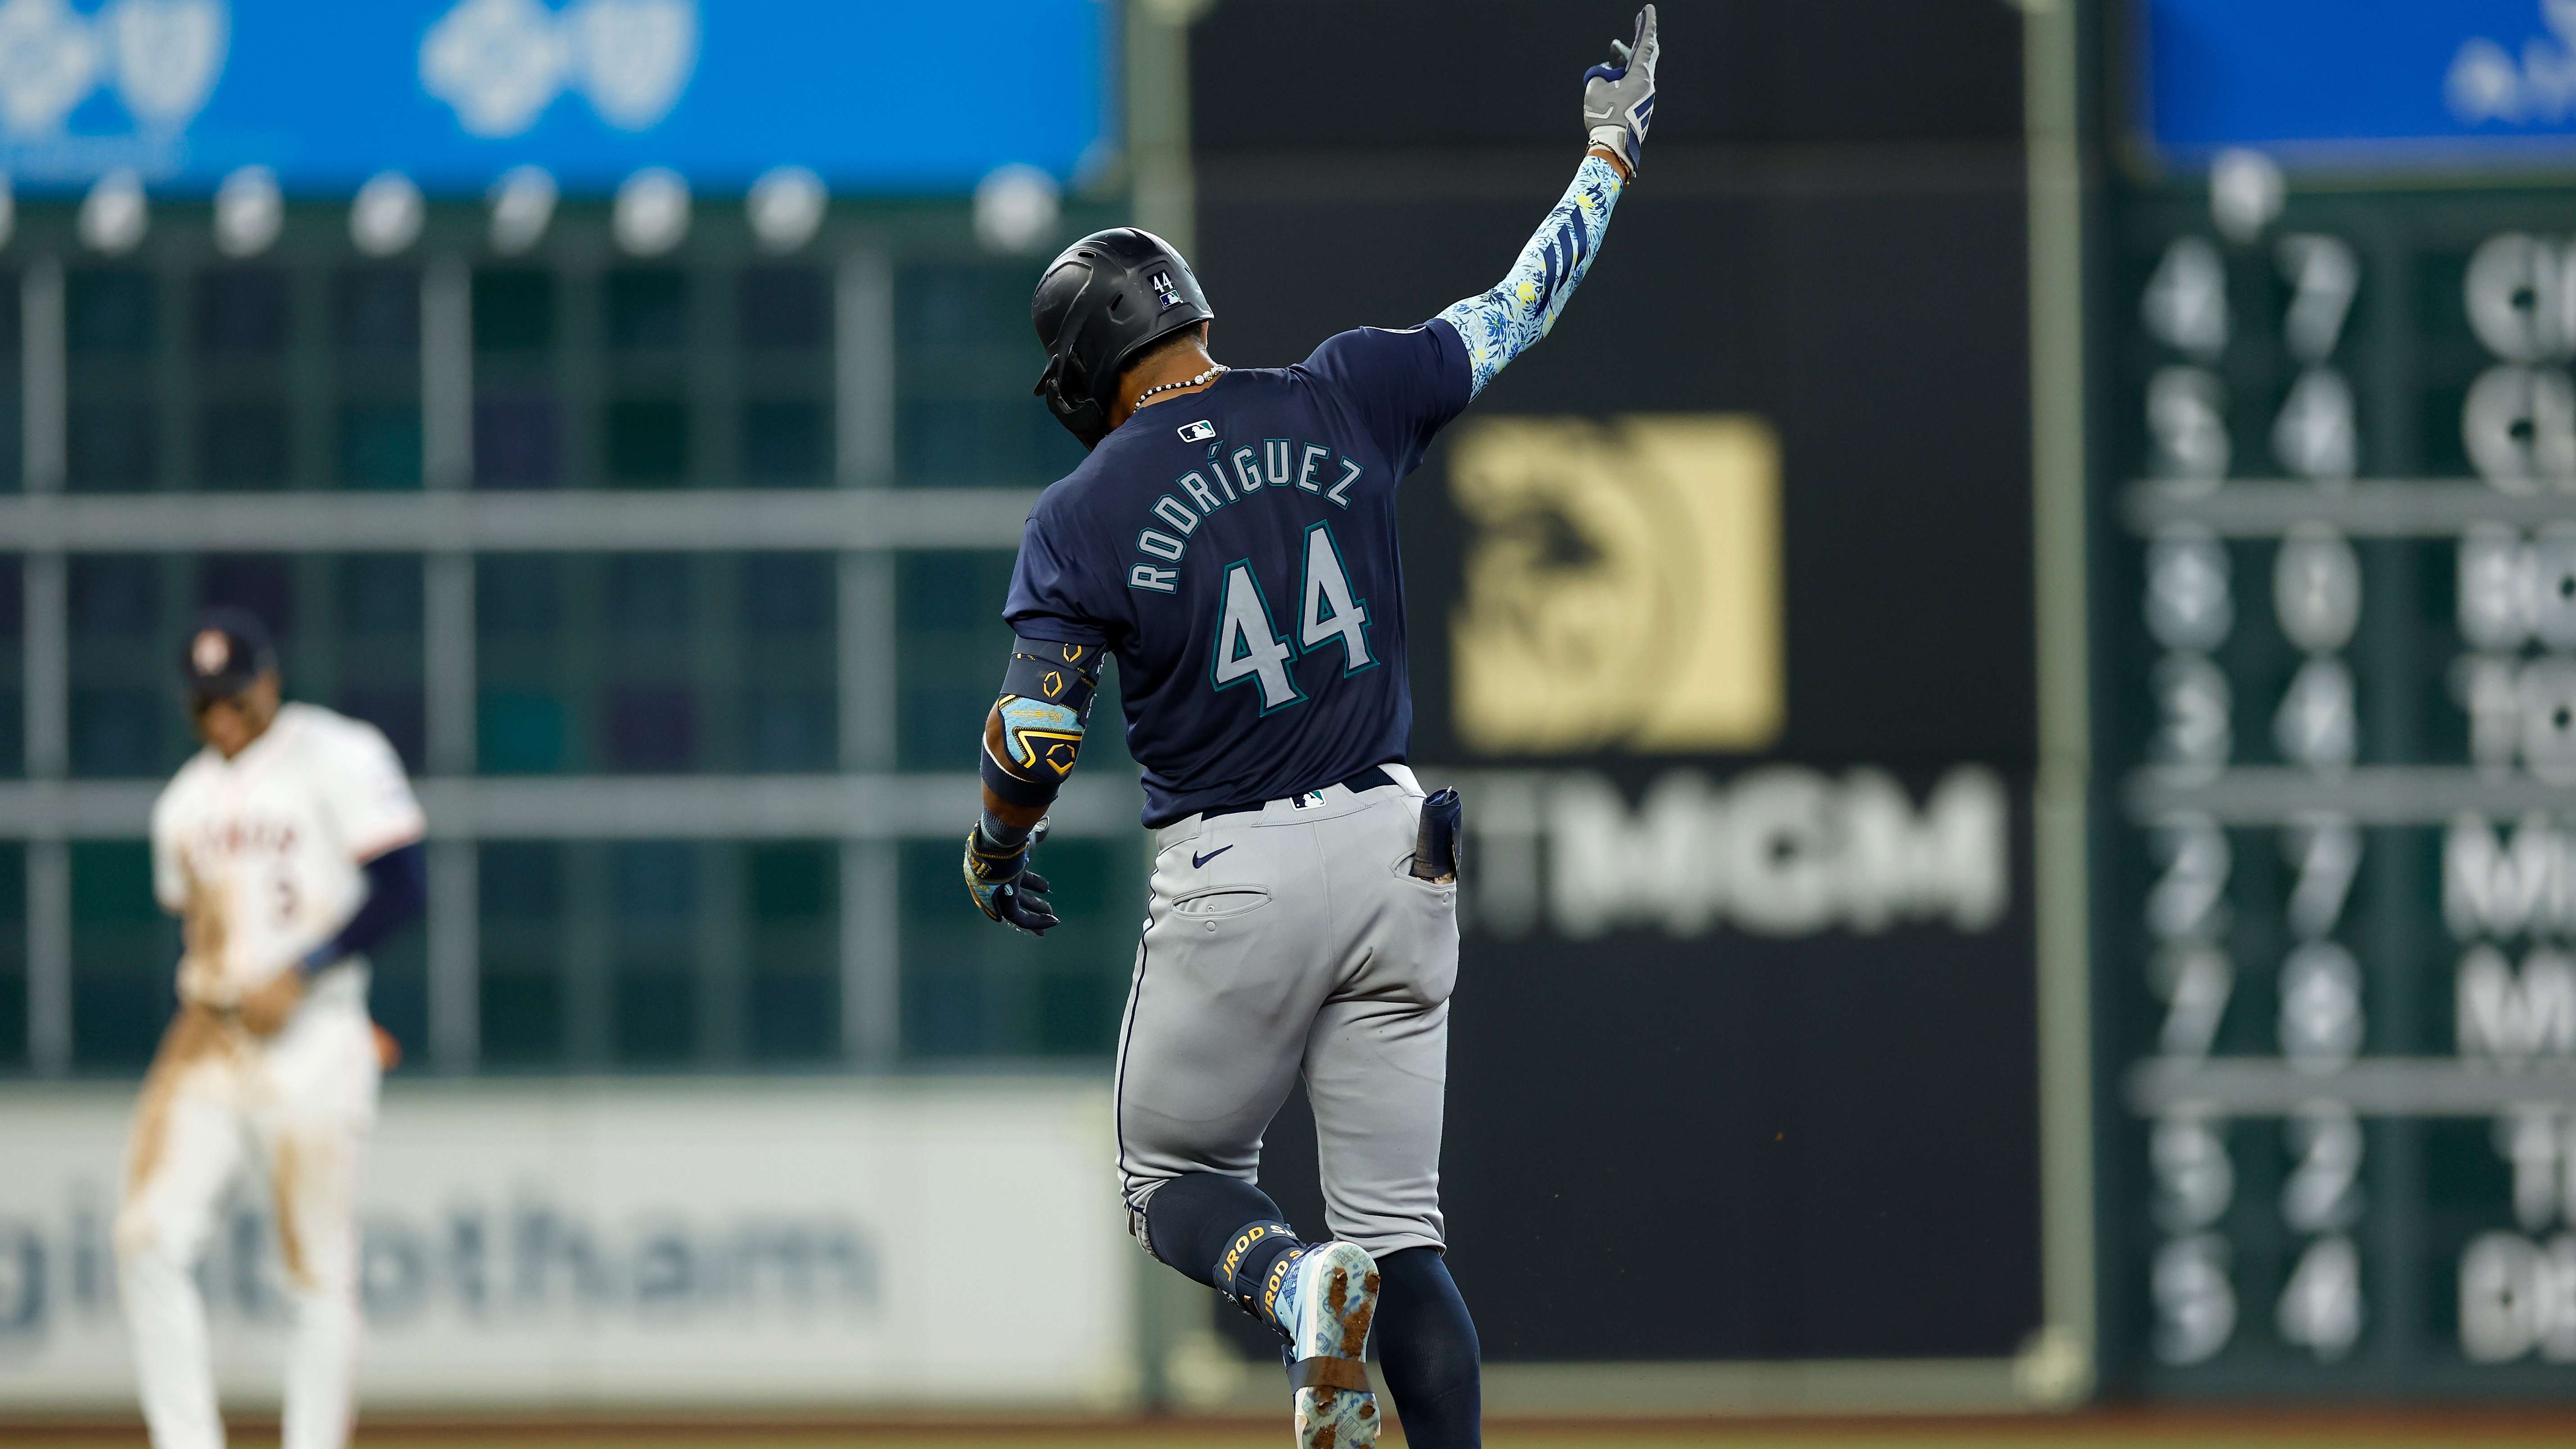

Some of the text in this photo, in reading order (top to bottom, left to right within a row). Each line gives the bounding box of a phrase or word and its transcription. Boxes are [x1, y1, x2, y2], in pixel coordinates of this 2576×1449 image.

[1154, 272, 1173, 293] 44
[1127, 438, 1364, 594] RODRÍGUEZ
[1210, 519, 1380, 717] 44
[1425, 765, 2009, 940] TMGM
[1222, 1226, 1265, 1282] JROD
[1264, 1260, 1289, 1323] JROD
